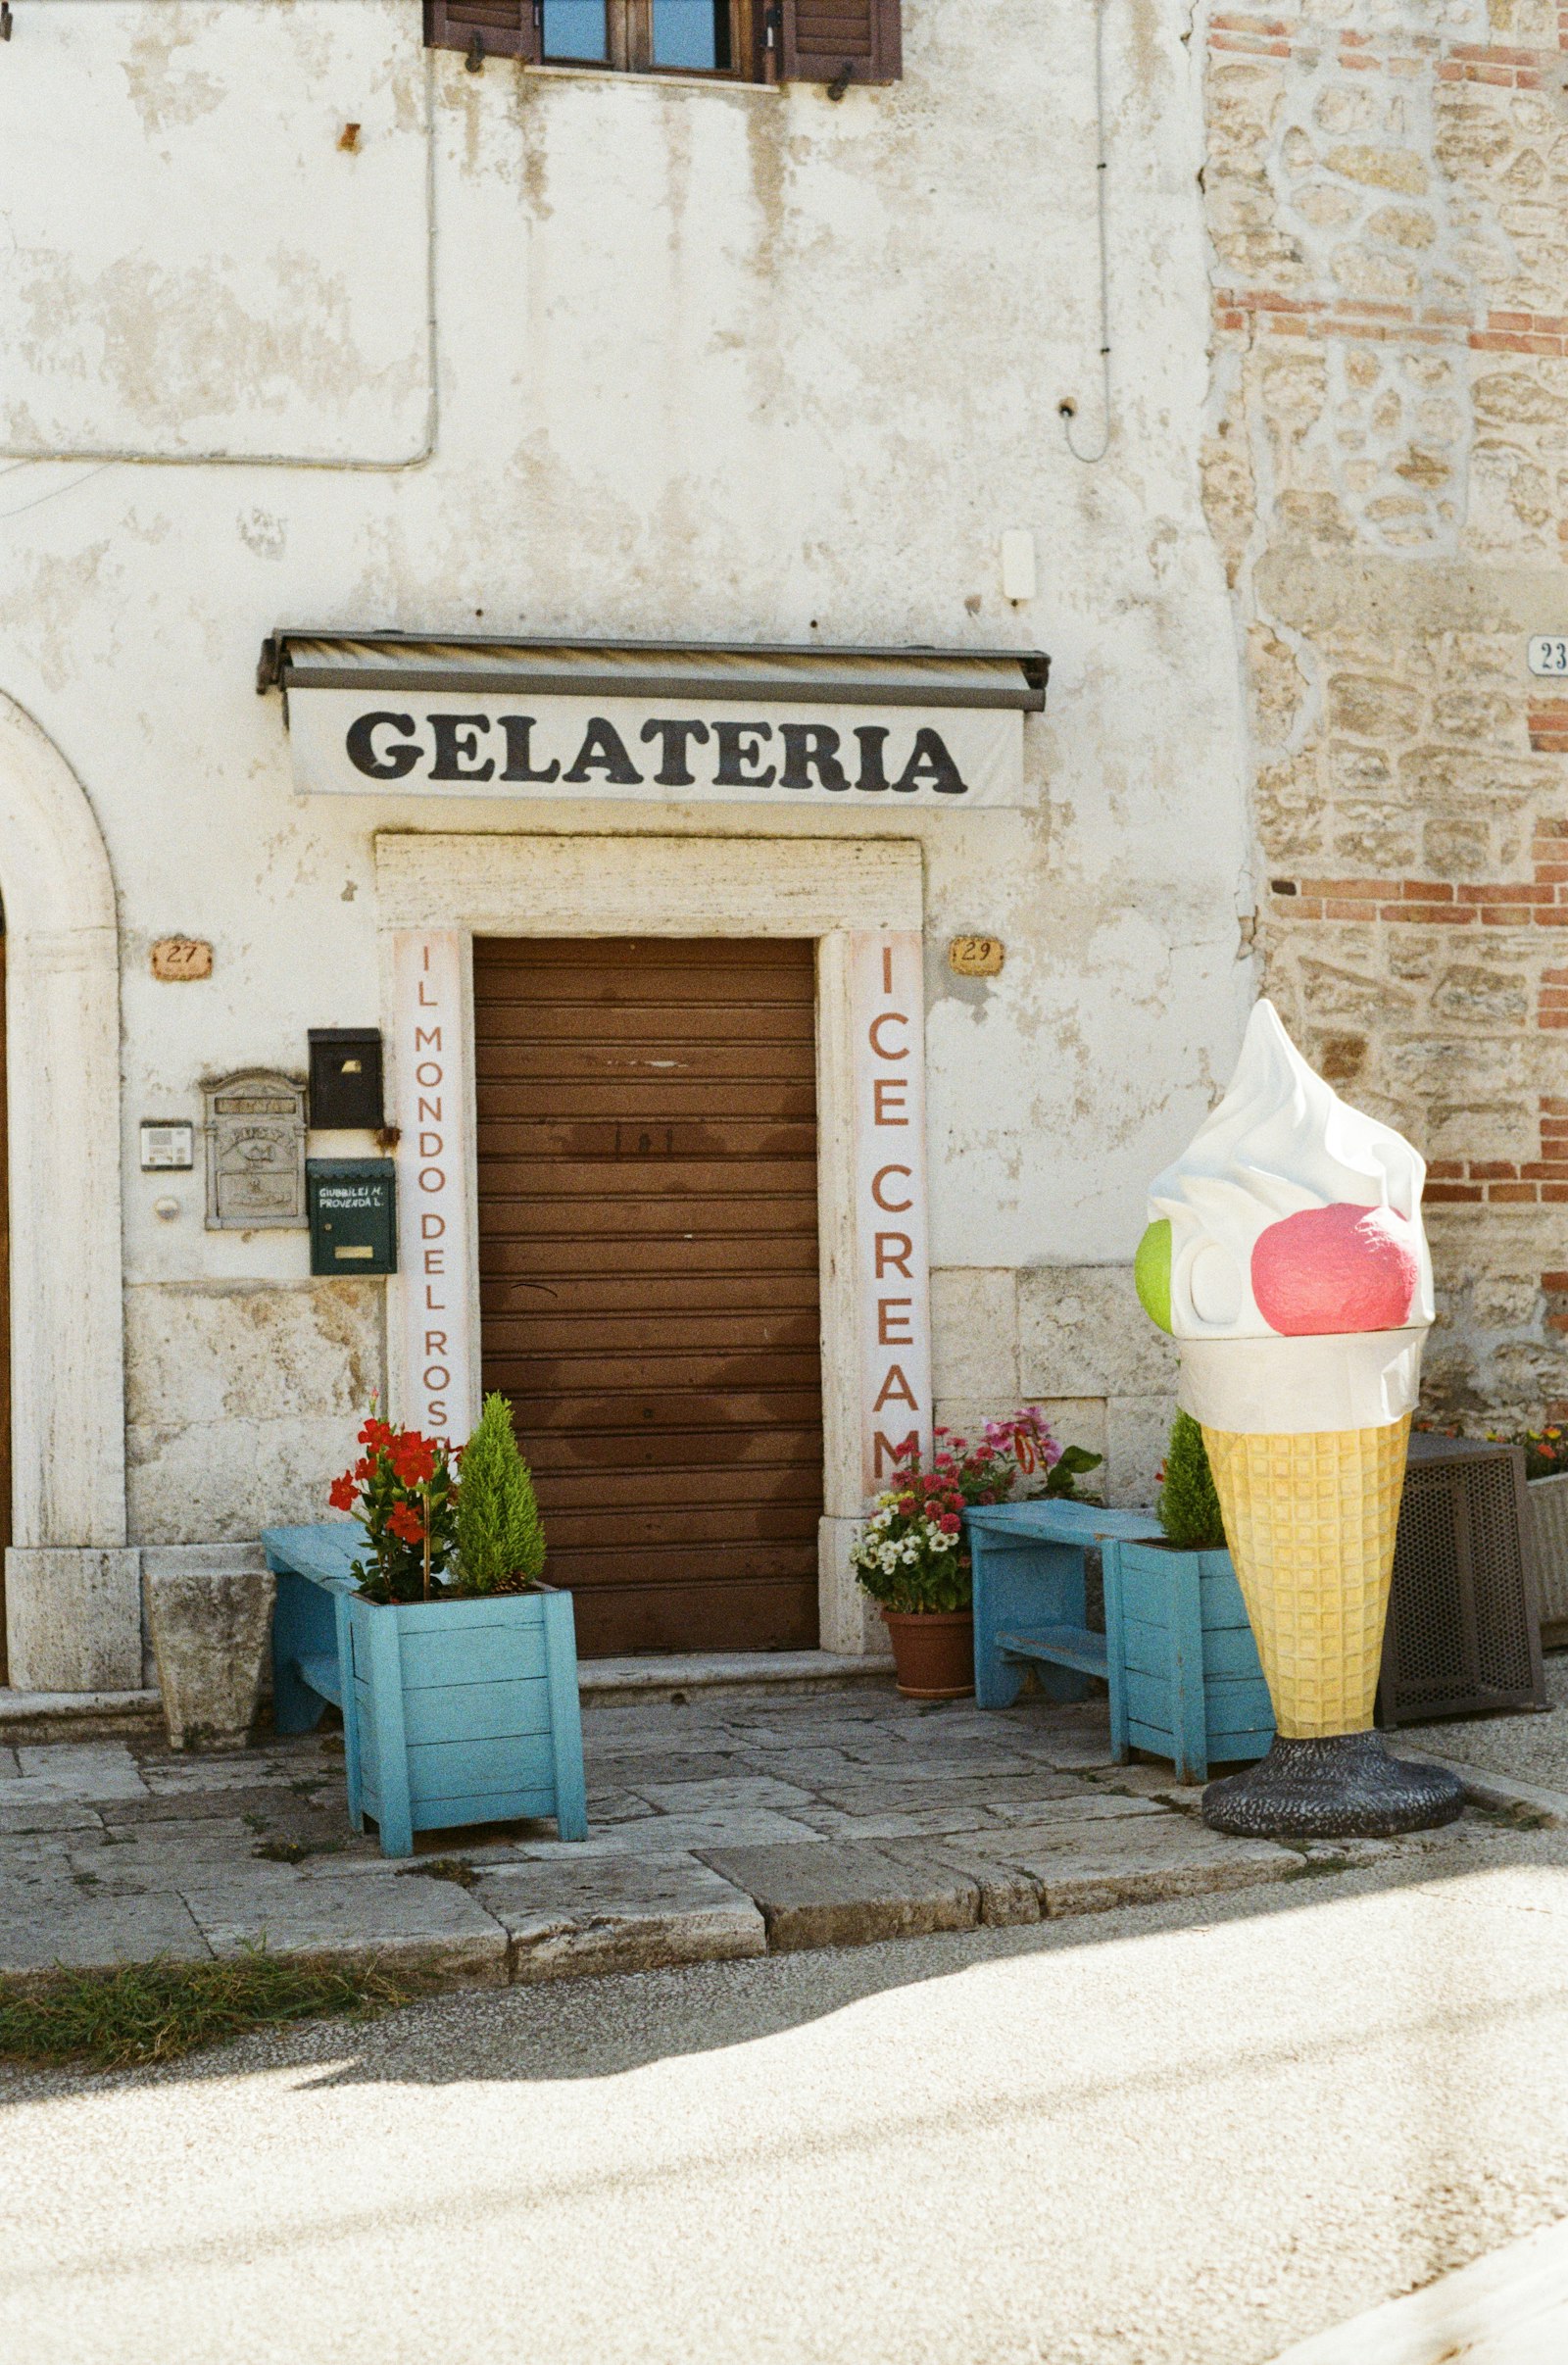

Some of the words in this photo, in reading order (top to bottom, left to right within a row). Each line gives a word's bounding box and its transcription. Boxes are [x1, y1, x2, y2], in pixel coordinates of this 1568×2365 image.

[1541, 642, 1567, 669] 23
[345, 710, 969, 795] GELATERIA
[167, 945, 197, 962] 27
[417, 945, 438, 1007] IL
[961, 941, 990, 961] 29
[868, 946, 910, 1126] ICE
[415, 1026, 446, 1193] MONDO
[420, 1212, 446, 1310] DEL
[870, 1163, 919, 1478] CREAM
[422, 1330, 451, 1443] ROS
